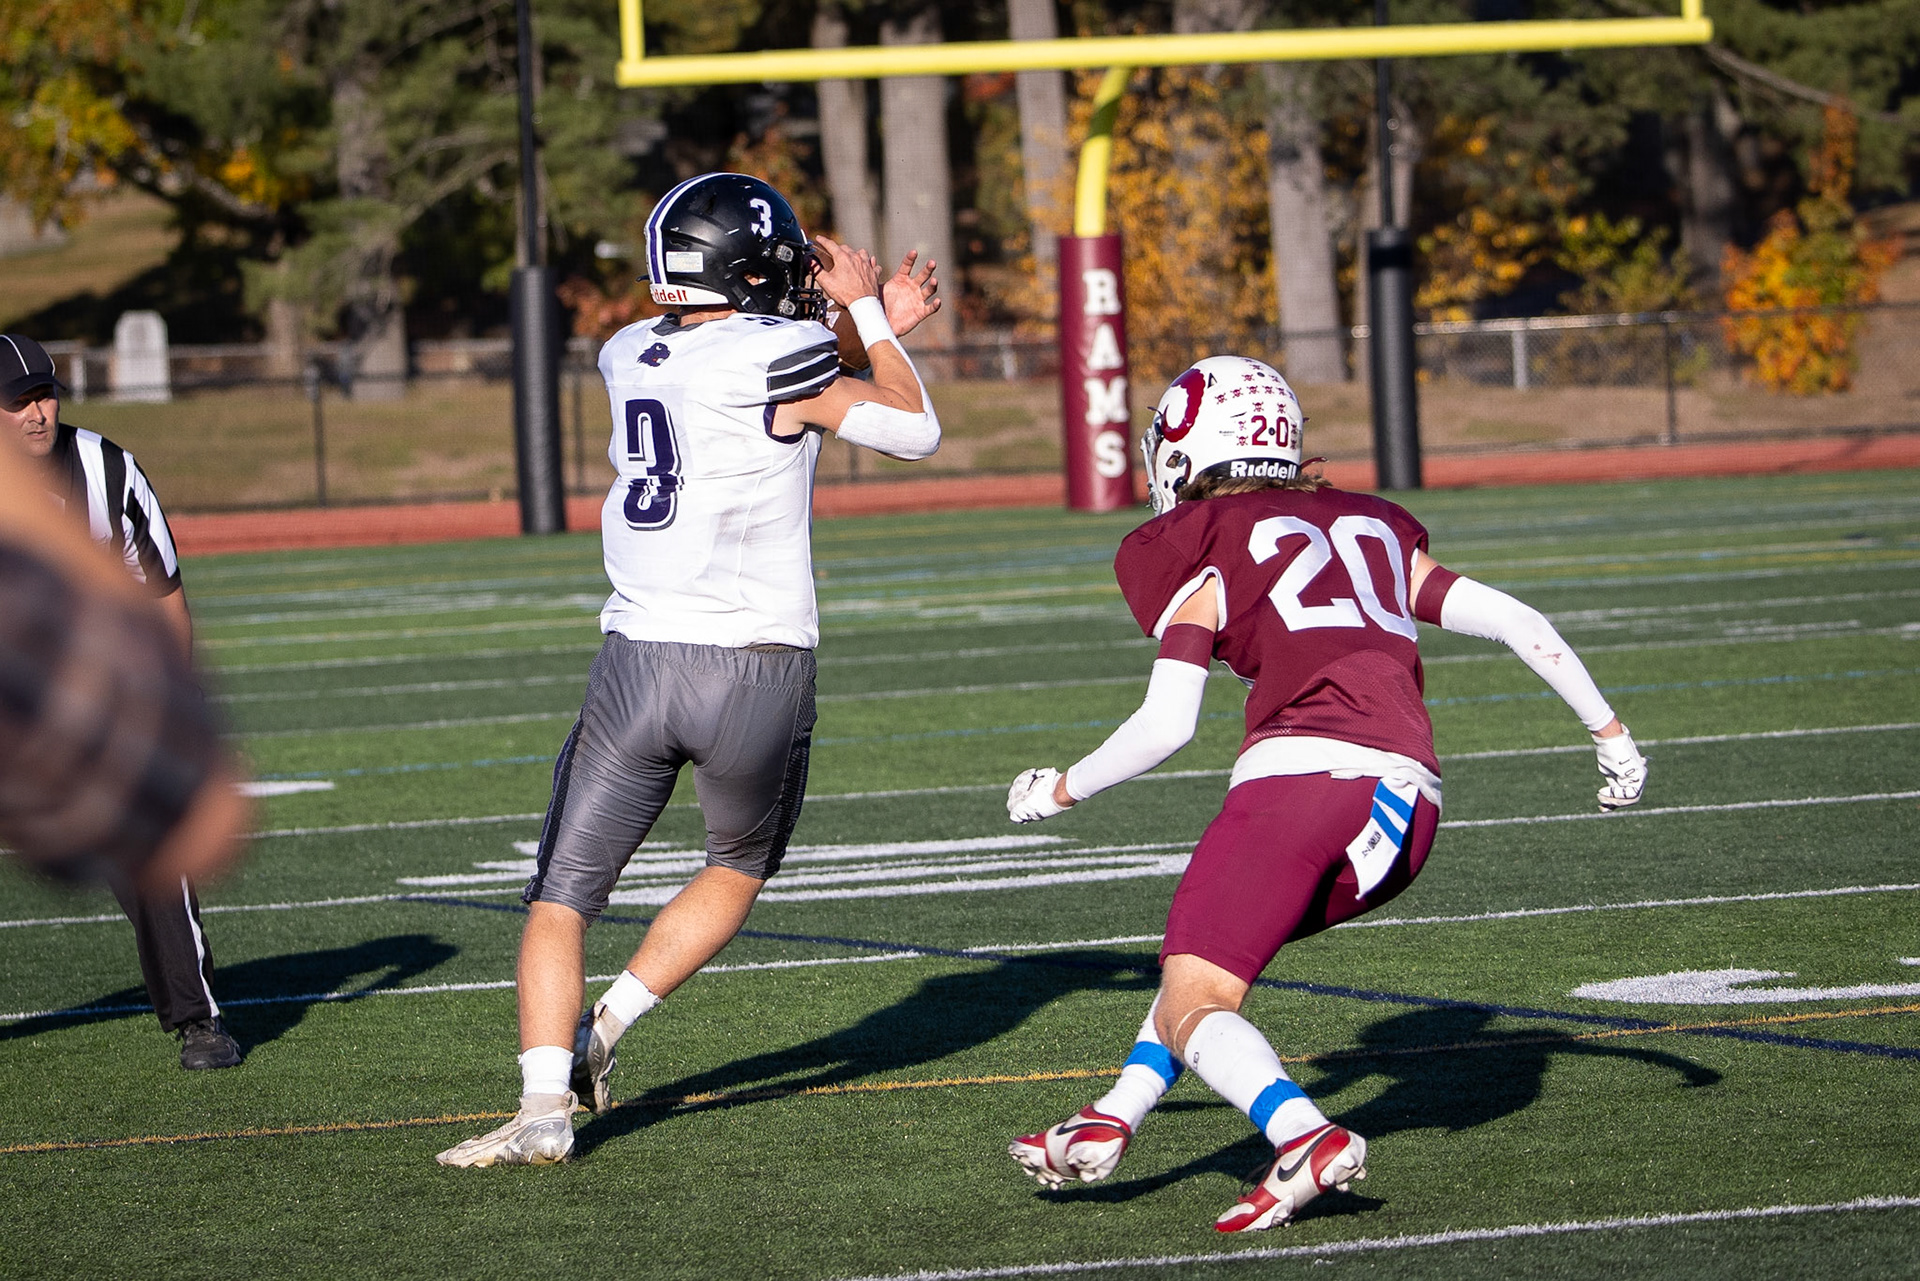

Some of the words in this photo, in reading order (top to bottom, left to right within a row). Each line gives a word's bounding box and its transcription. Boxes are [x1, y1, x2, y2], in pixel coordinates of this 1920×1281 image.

[749, 198, 773, 238] 3
[1082, 267, 1130, 478] RAMS
[623, 398, 684, 531] 3
[1230, 460, 1298, 480] Riddell
[1251, 415, 1289, 447] 20
[1248, 515, 1418, 642] 20
